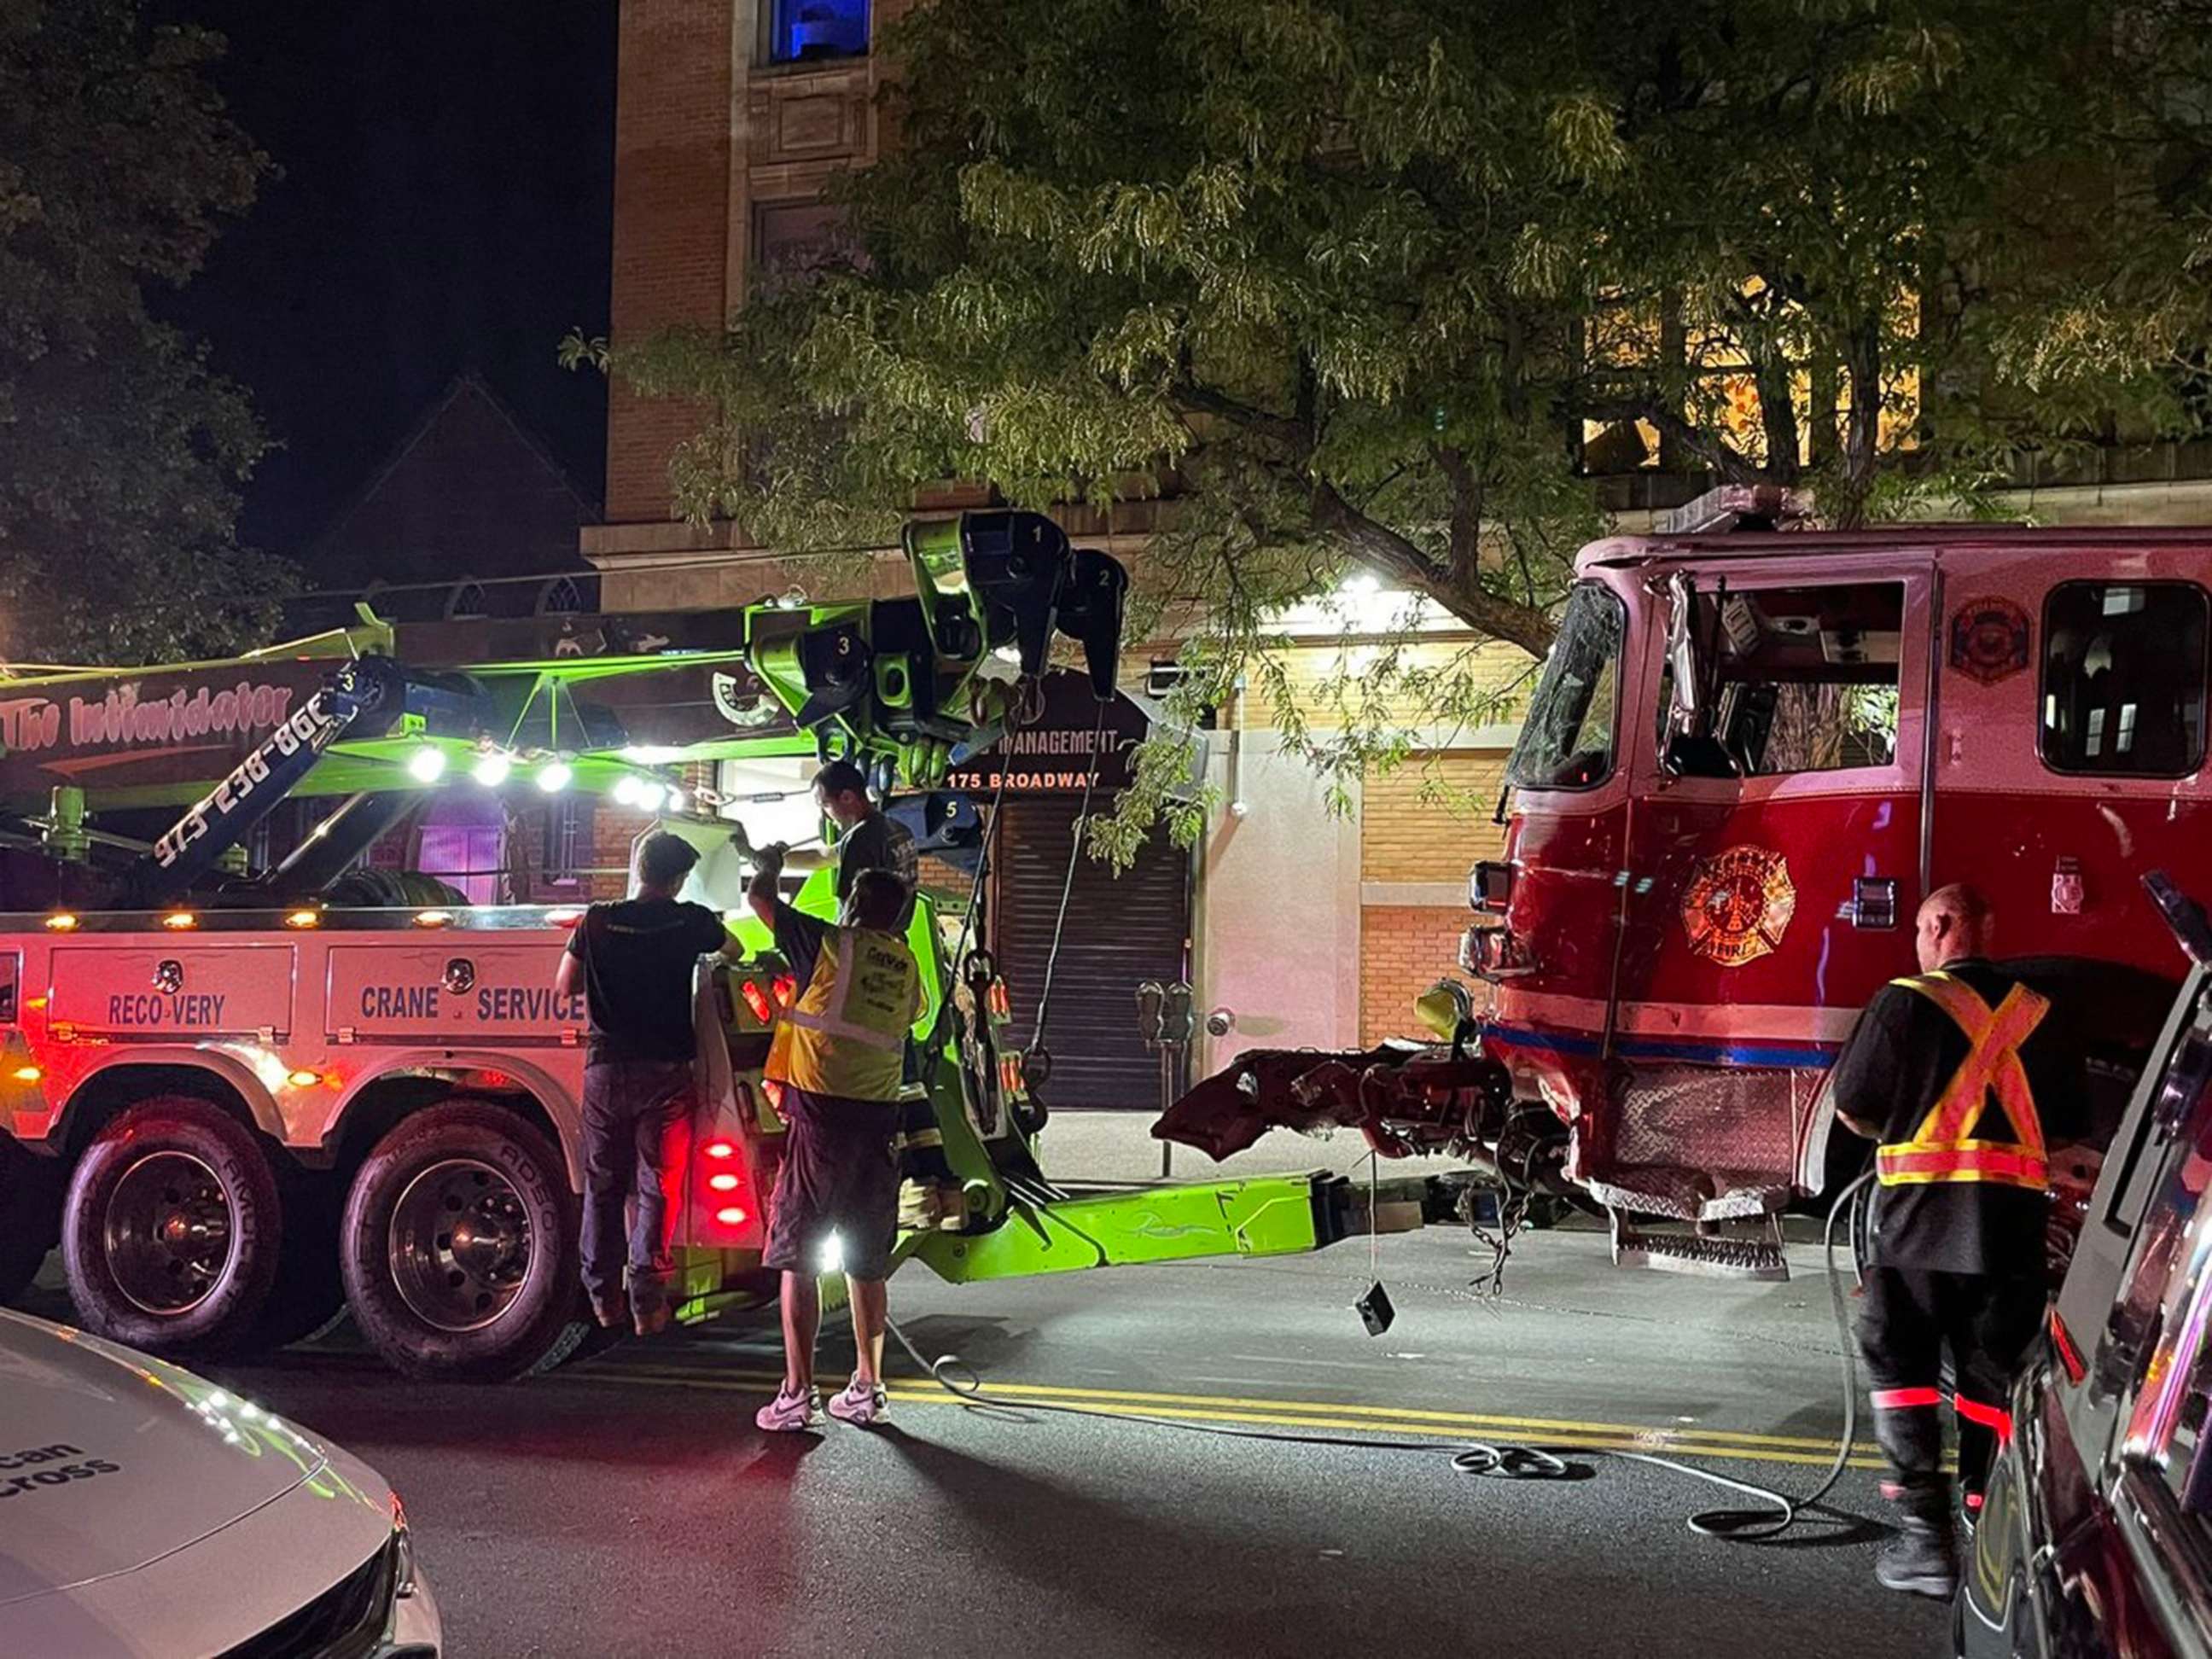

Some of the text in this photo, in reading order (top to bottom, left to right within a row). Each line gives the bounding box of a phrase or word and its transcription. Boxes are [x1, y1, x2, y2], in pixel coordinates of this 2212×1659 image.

[1033, 525, 1043, 542] 1
[1099, 569, 1109, 586] 2
[839, 637, 850, 655] 3
[70, 682, 292, 746] Intimidator
[154, 691, 334, 868] 973-238-866
[947, 772, 1099, 788] 175 BROADWAY
[946, 800, 957, 818] 5
[361, 986, 585, 1021] CRANE SERVICE
